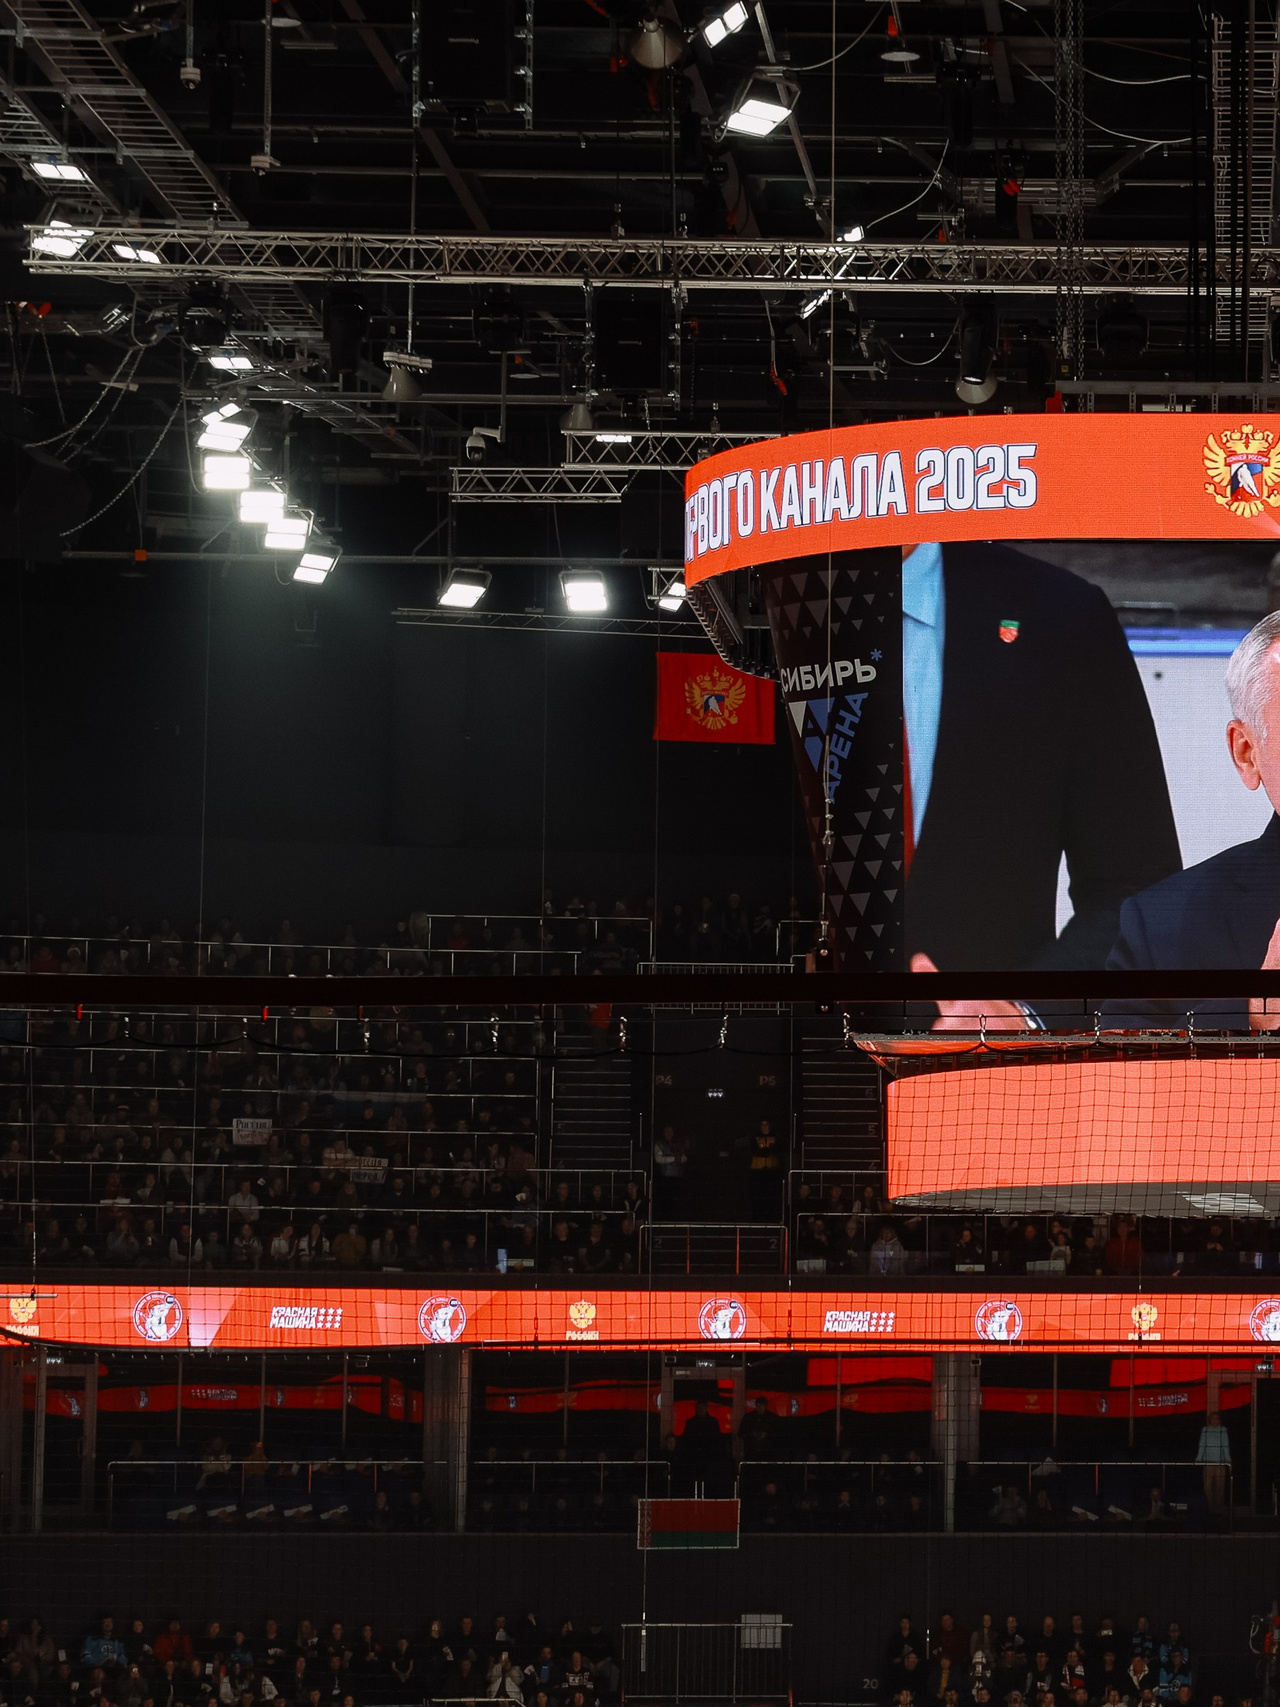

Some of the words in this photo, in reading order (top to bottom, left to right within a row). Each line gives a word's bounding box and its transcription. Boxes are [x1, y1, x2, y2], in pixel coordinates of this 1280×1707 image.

[759, 450, 908, 533] КАНАЛА
[914, 443, 1039, 515] 2025
[780, 658, 877, 693] СИБИРЬ
[822, 692, 869, 805] АРЕНА
[271, 1306, 318, 1317] КРАСНАЯ
[825, 1310, 871, 1321] КРАСНАЯ
[269, 1316, 316, 1329] МАШИНА
[823, 1320, 869, 1332] МАШИНА
[863, 1678, 879, 1689] 20
